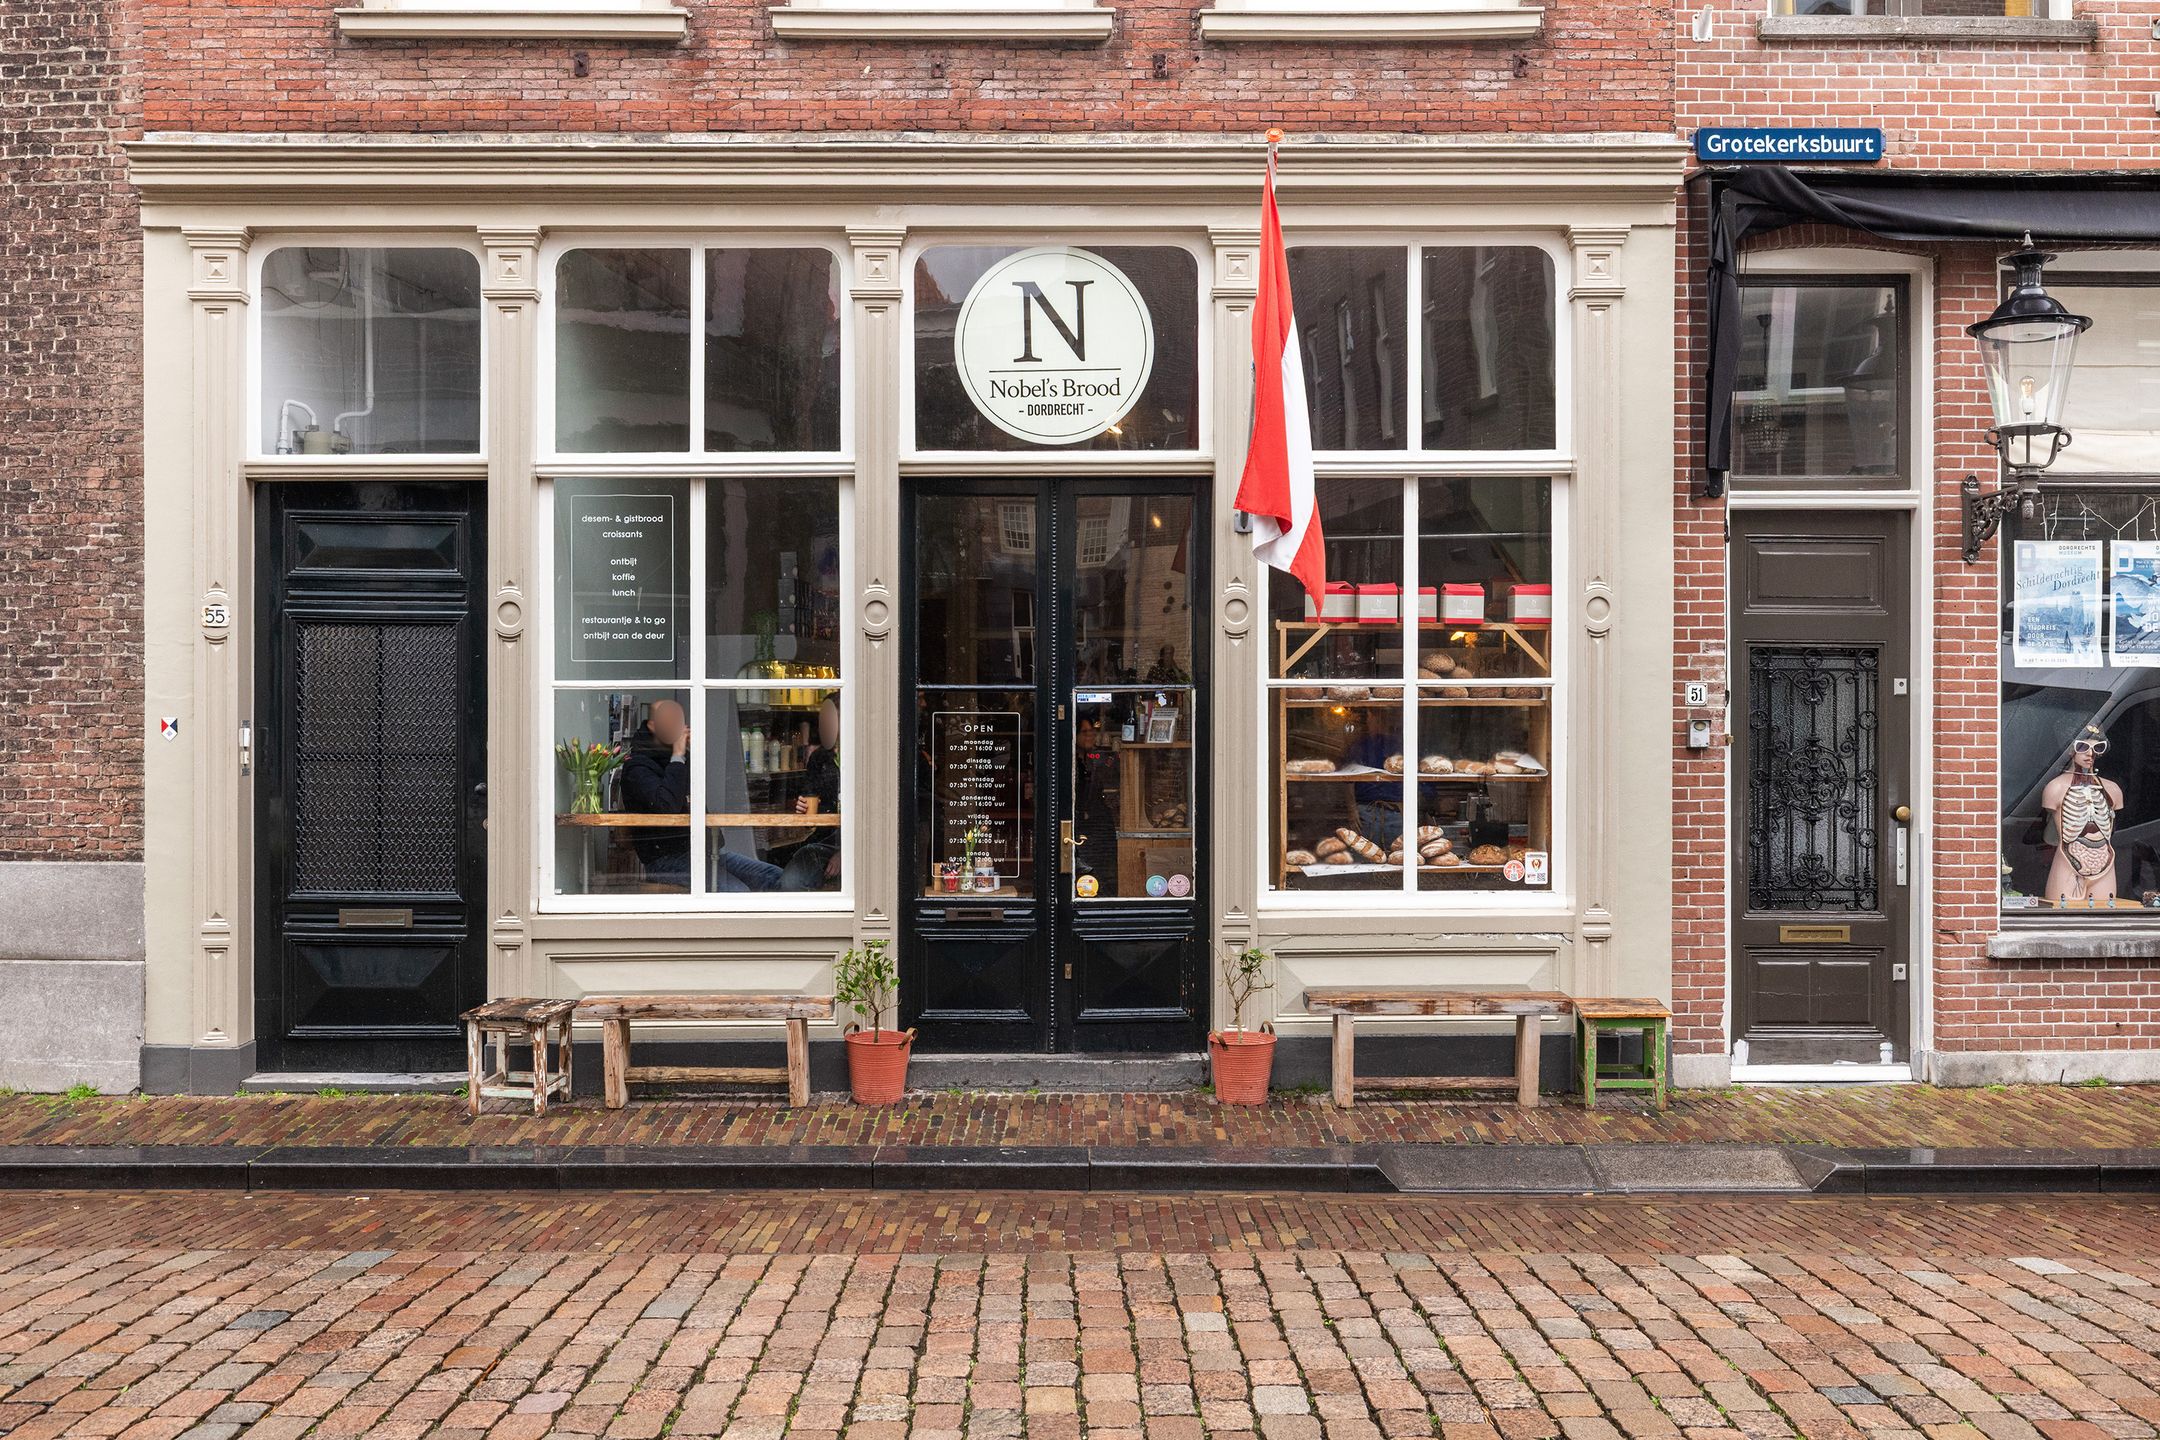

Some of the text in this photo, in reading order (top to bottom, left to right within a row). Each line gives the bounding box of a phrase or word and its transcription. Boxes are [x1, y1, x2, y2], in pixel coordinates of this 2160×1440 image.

[1707, 134, 1874, 153] Grotekerksbuurt
[1012, 280, 1095, 363] N
[1062, 377, 1121, 397] Brood
[1027, 403, 1085, 417] DORDRECHT
[581, 515, 664, 524] desem- & gistbrood
[602, 530, 643, 538] croissants
[610, 557, 637, 566] ontbijt
[612, 573, 636, 581] koffie
[2016, 565, 2084, 591] Schilderachtig
[2053, 570, 2099, 592] Dordrecht
[612, 589, 636, 597] lunch
[205, 609, 225, 624] 55
[581, 616, 666, 626] restaurantje & to go
[583, 631, 610, 641] ontbijt
[631, 631, 643, 640] de
[645, 631, 665, 640] deur
[1691, 687, 1703, 702] 51
[964, 724, 994, 733] OPEN
